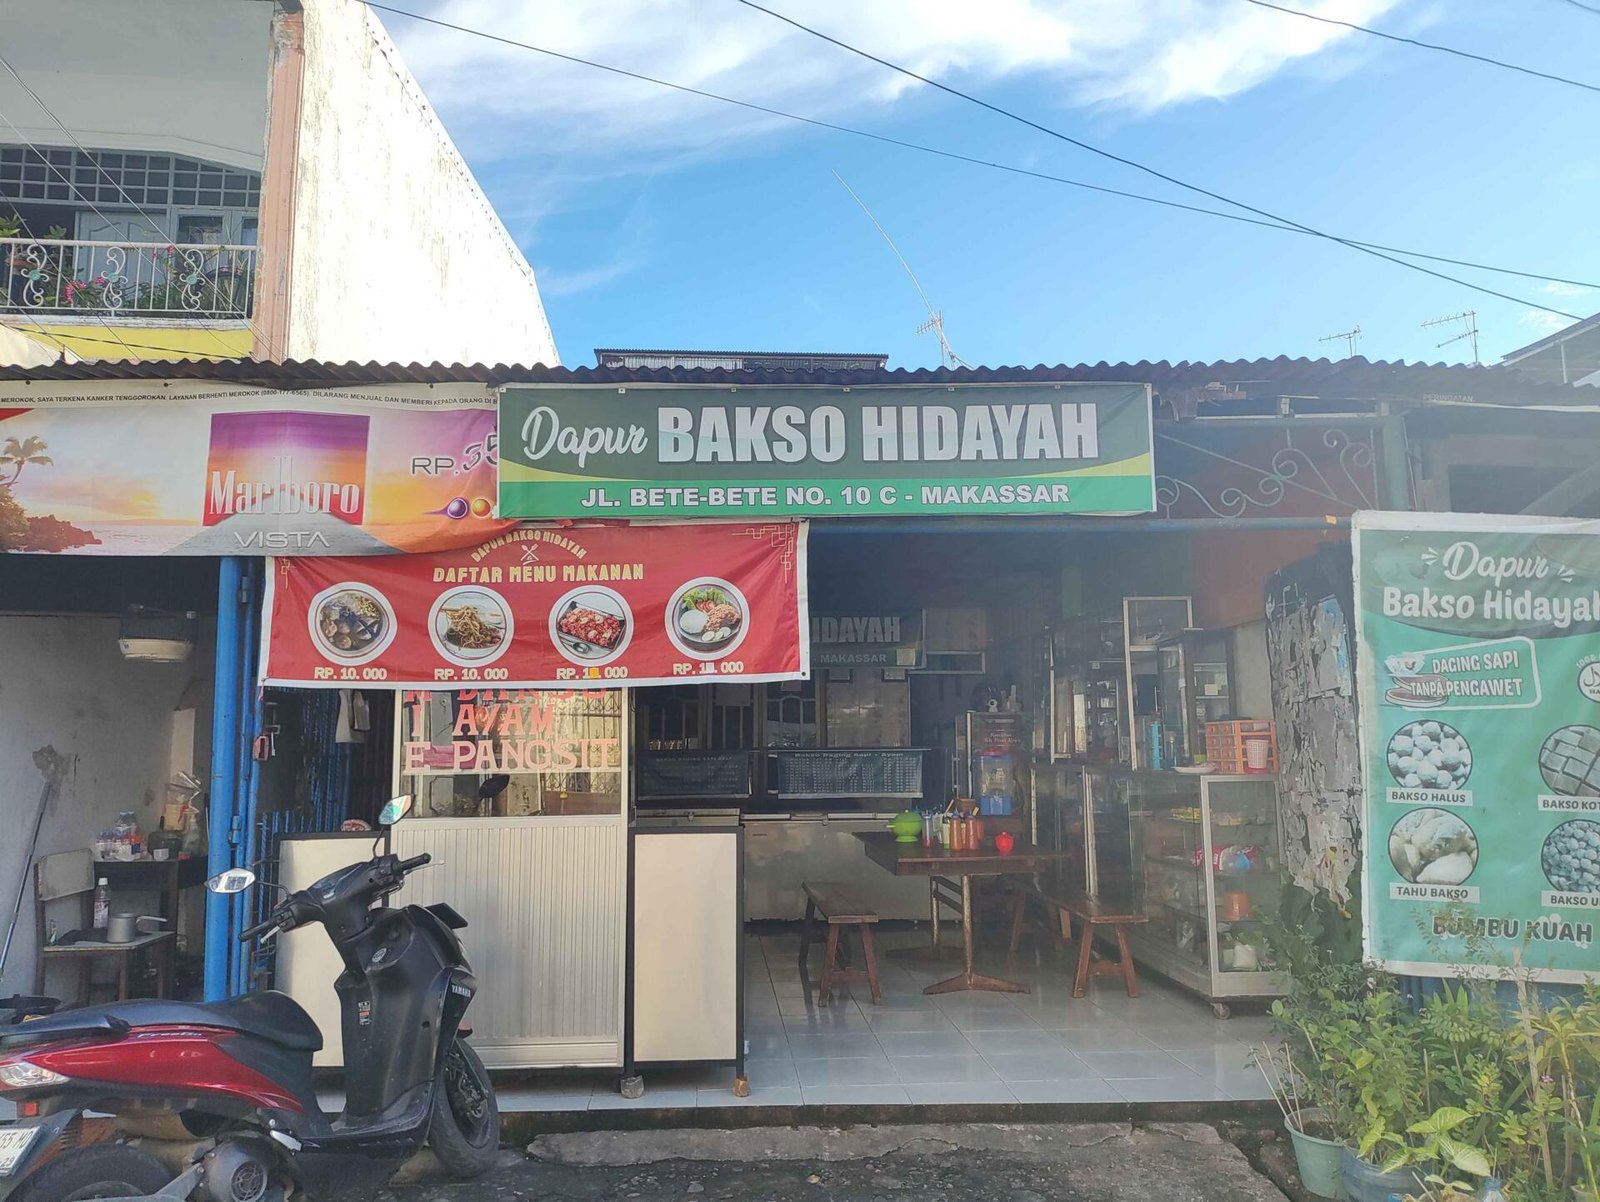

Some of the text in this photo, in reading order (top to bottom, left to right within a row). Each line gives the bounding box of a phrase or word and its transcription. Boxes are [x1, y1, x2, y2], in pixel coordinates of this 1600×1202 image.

[198, 391, 228, 400] BERHENTI
[228, 390, 260, 398] MEROKOK
[312, 391, 348, 399] DILARANG
[350, 393, 382, 402] MENJUAL
[400, 398, 432, 406] MEMBERI
[433, 398, 457, 406] KEPADA
[521, 403, 1099, 469] Dapur BAKSO HIDAYAH
[208, 456, 361, 516] Marlboro
[581, 489, 621, 507] JL.
[630, 488, 777, 506] BETE-BETE
[786, 487, 831, 505] NO.
[841, 486, 871, 504] 10
[879, 486, 897, 504] C
[921, 484, 1070, 504] MAKASSAR
[233, 531, 331, 549] VISTA
[505, 530, 541, 543] BAKSO
[542, 531, 587, 559] HIDAYAH
[432, 563, 644, 583] DAFTAR MENU MAKANAN
[1442, 541, 1549, 587] Dapur
[1383, 586, 1475, 619] Bakso
[820, 653, 887, 663] MAKASSAR
[1432, 650, 1519, 674] DAGING SAPI
[314, 667, 387, 680] RP. 10. 000
[434, 668, 509, 681] RP. 10. 000
[556, 667, 580, 680] RP.
[604, 667, 629, 679] 000
[672, 663, 696, 676] RP.
[720, 661, 745, 674] 000
[1411, 678, 1523, 696] TANPA PENGAWET
[452, 703, 556, 736] AYAM
[452, 738, 617, 773] PANGSIT
[1391, 791, 1466, 803] BAKSO HALUS
[1542, 799, 1579, 809] BAKSO
[1397, 887, 1468, 900] TAHU BAKSO
[1550, 895, 1588, 906] BAKSO
[1526, 920, 1592, 942] KUAH
[451, 984, 471, 998] YAMAHA
